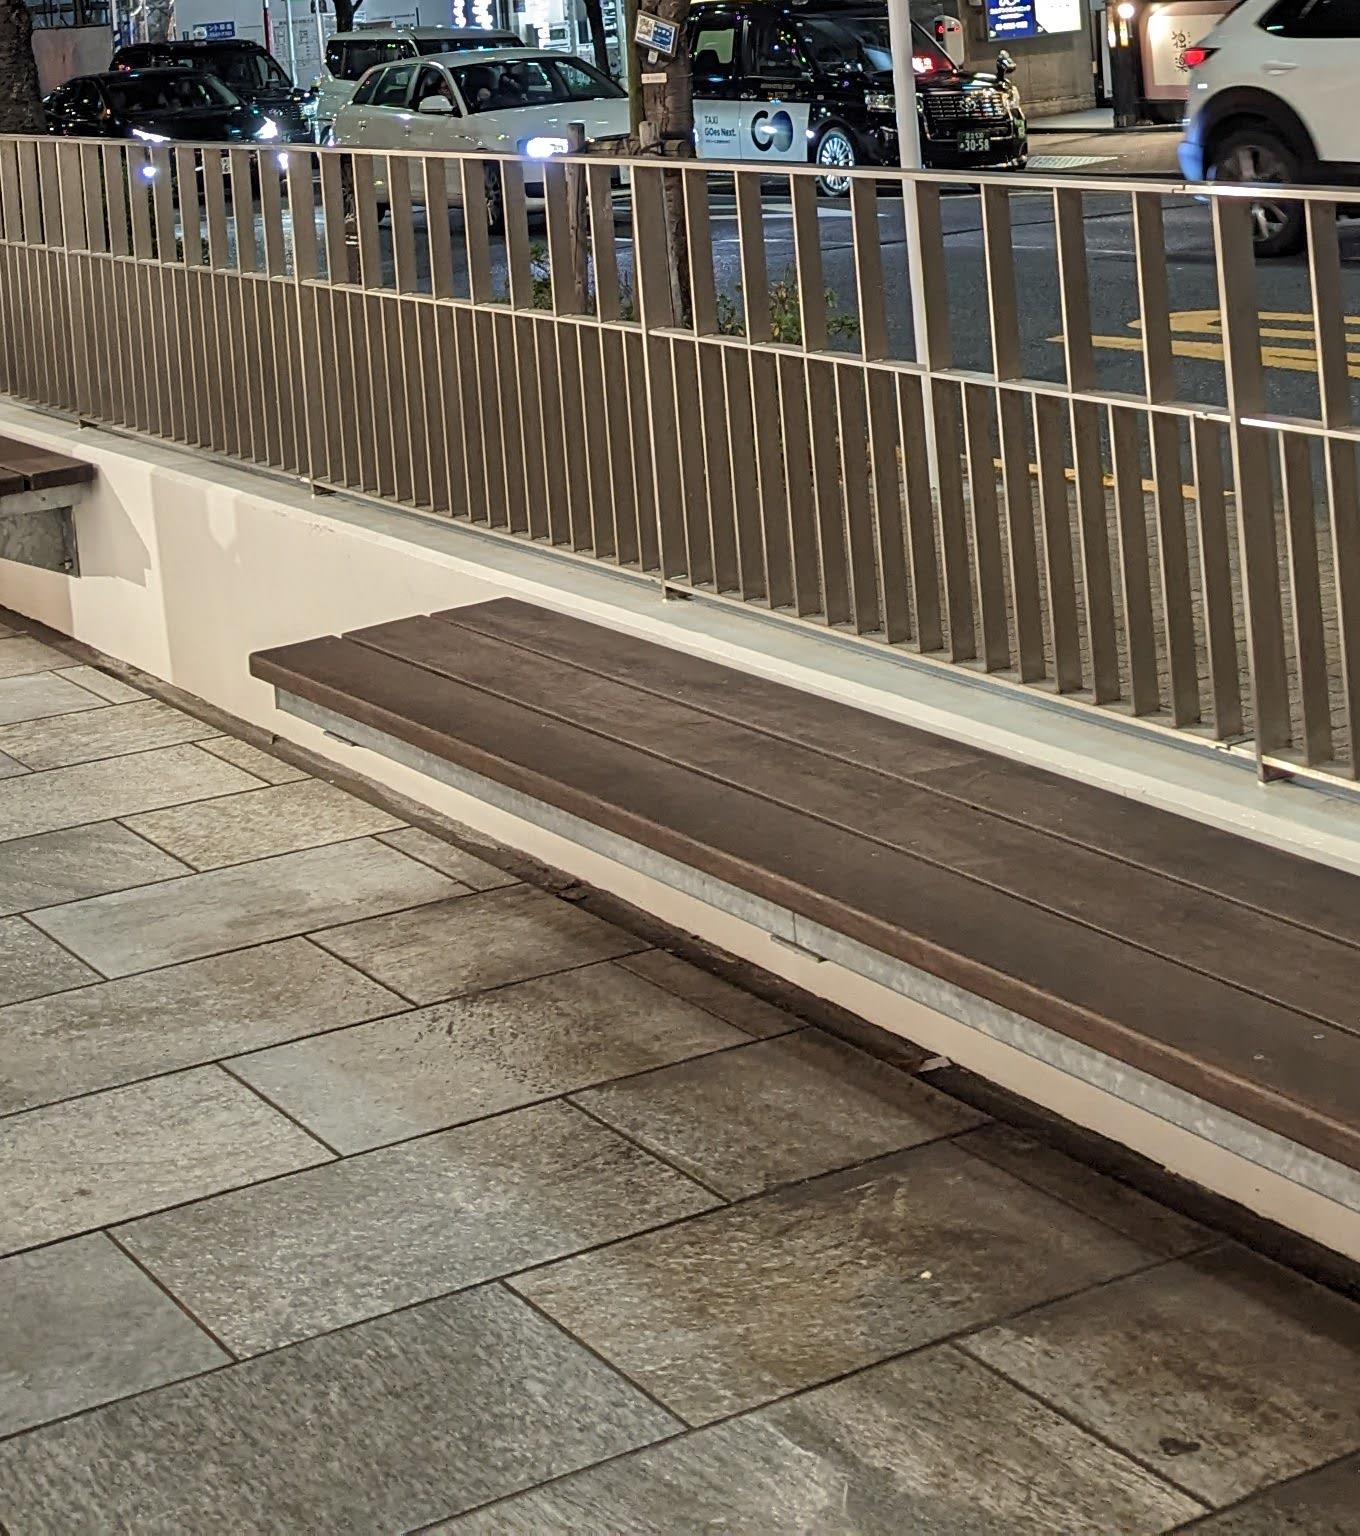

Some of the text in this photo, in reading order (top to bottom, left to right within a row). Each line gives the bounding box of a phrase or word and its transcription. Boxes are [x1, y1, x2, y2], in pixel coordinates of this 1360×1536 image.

[704, 115, 719, 125] TAXI
[704, 127, 720, 137] GOes
[965, 139, 990, 152] 30-58
